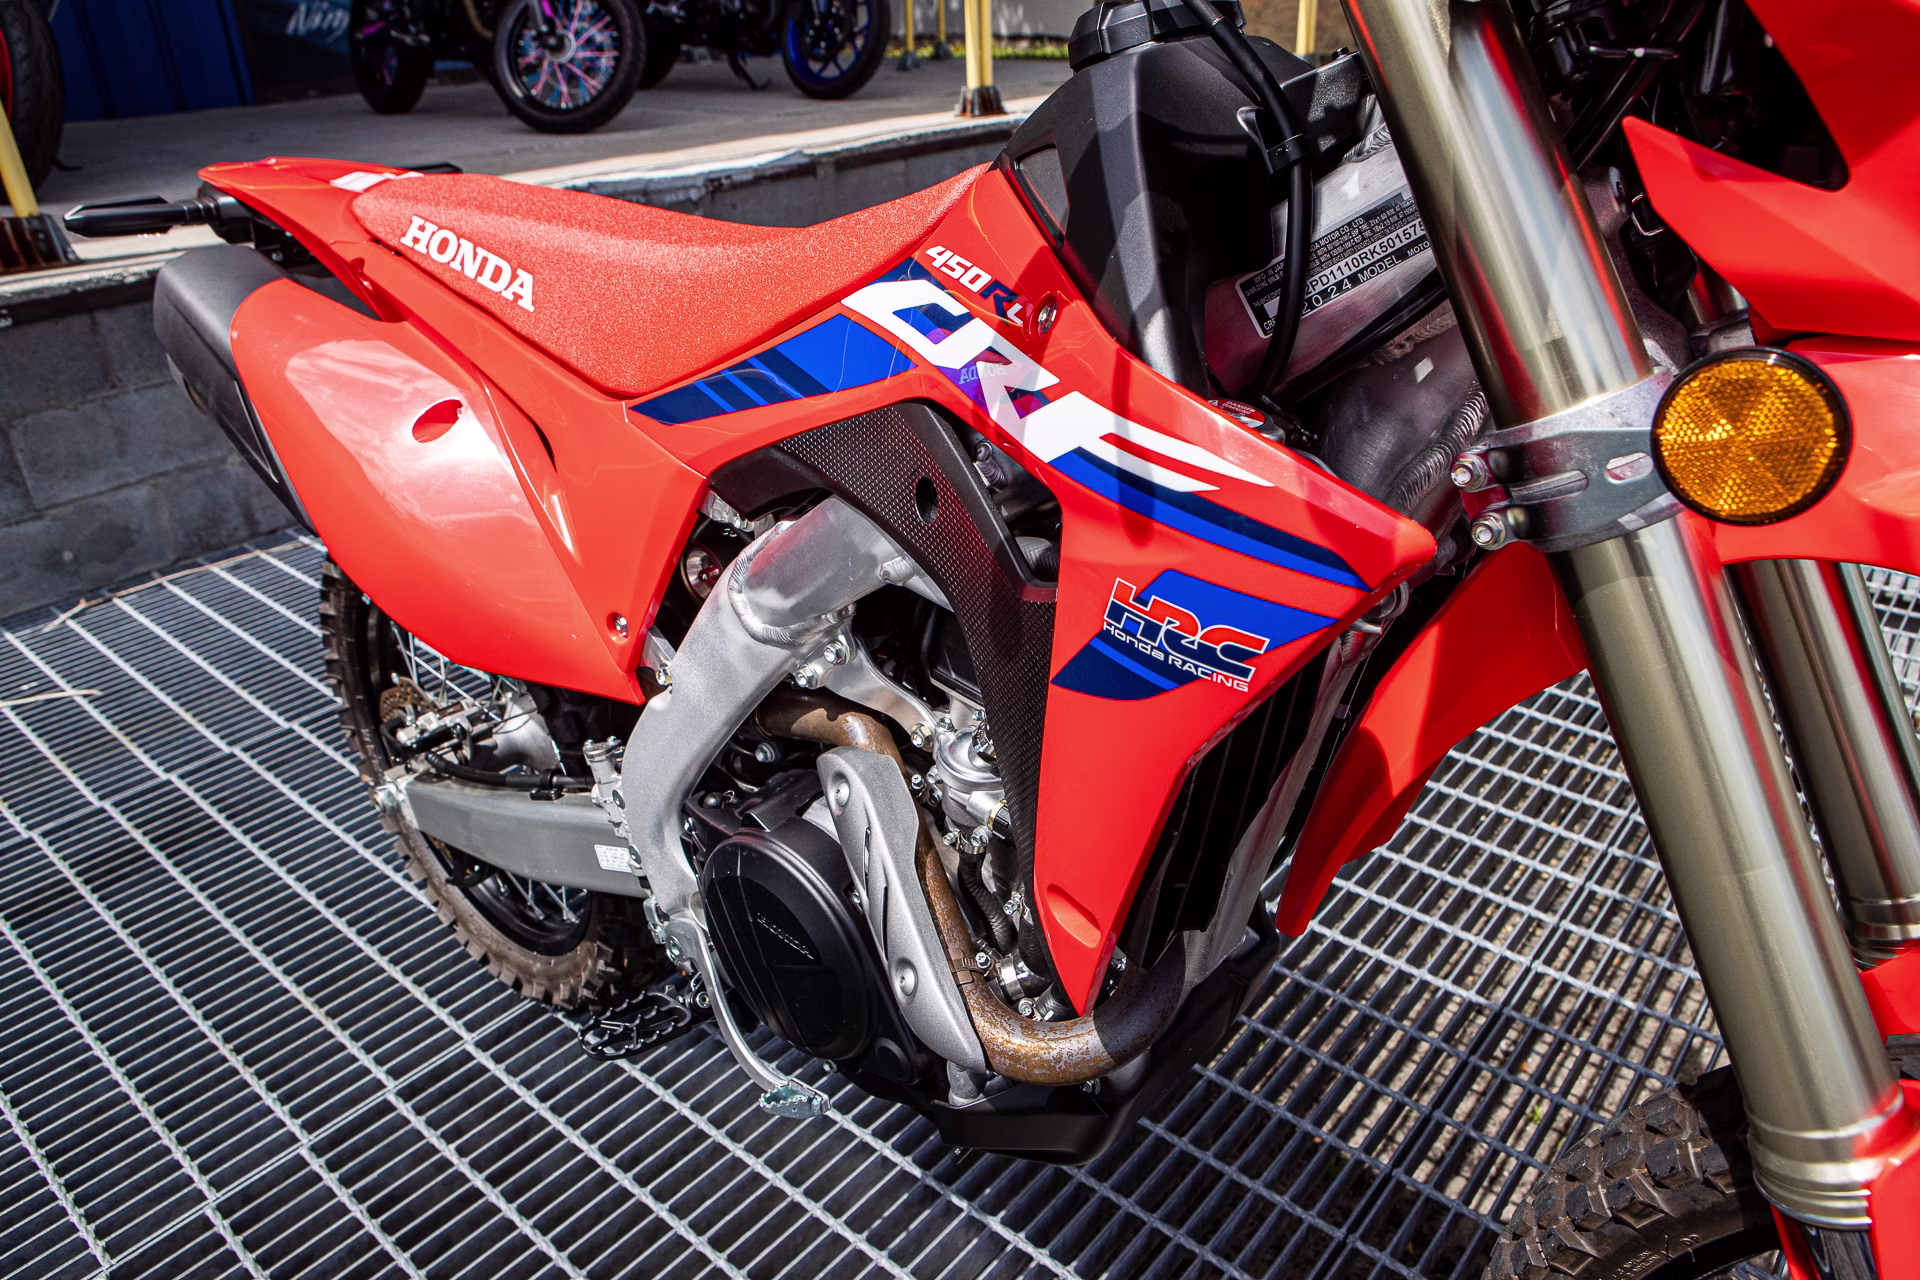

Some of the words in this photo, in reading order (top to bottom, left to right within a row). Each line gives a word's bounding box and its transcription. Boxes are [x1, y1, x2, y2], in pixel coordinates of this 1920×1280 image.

[400, 215, 534, 312] HONDA
[1272, 260, 1287, 272] JAP
[1318, 230, 1340, 246] MOTOR
[1358, 254, 1402, 283] MODEL
[840, 279, 1275, 492] CRF
[1103, 621, 1165, 661] Honda
[1168, 654, 1248, 692] RACING
[1104, 577, 1271, 682] HRC
